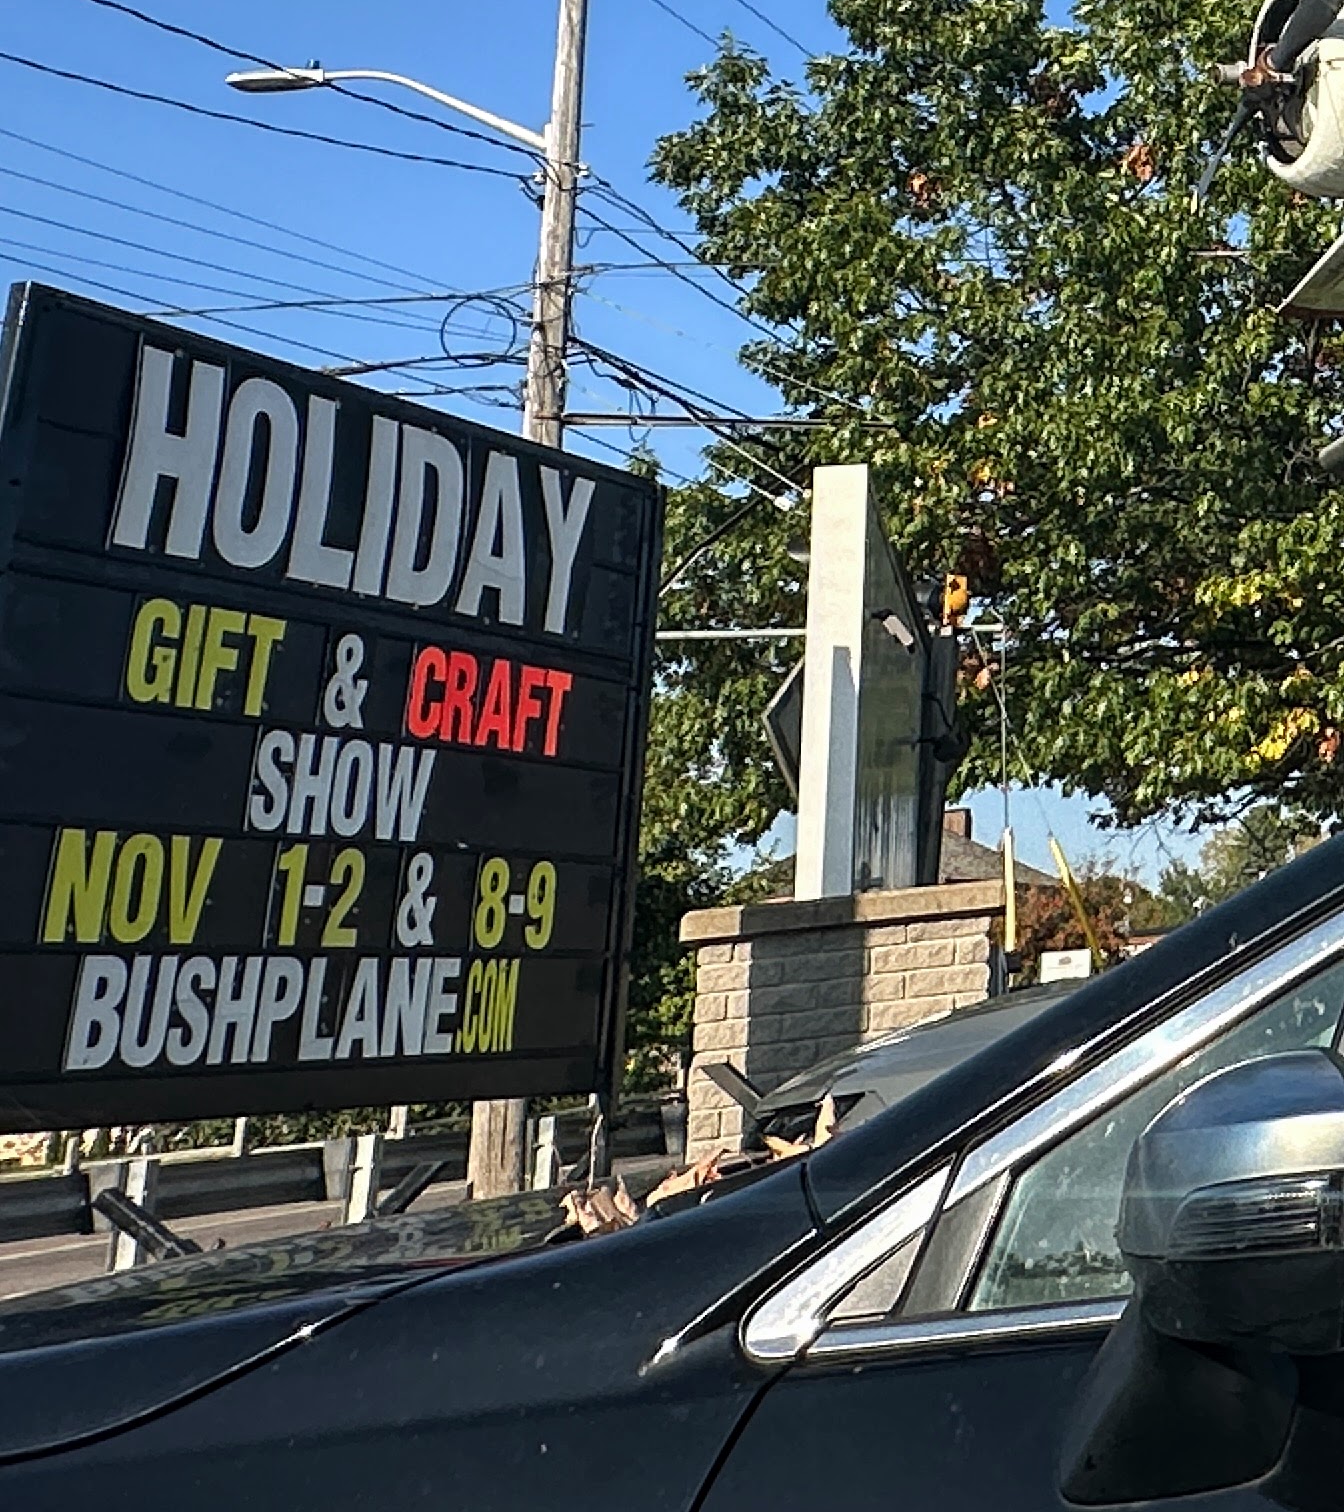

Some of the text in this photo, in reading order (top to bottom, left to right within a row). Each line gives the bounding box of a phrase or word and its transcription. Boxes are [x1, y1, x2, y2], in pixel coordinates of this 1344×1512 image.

[112, 345, 597, 635] HOLIDAY
[127, 598, 573, 757] GIFT & CRAFT
[250, 730, 437, 842] SHOW
[43, 828, 556, 950] NOV 1-2 & 8-9
